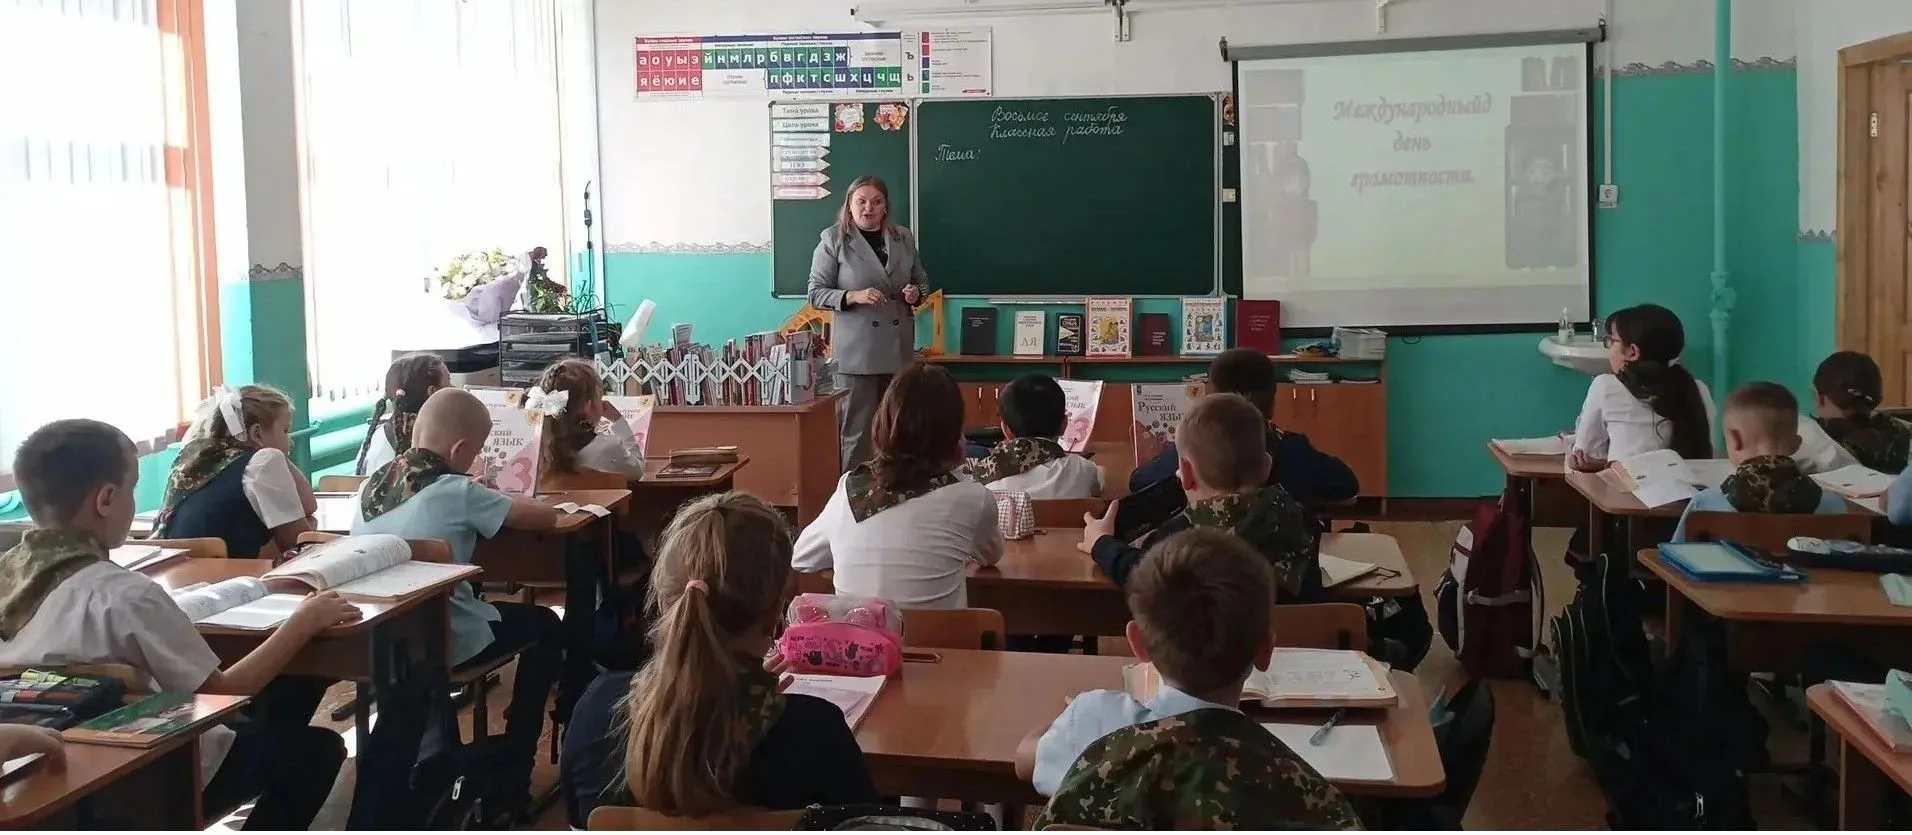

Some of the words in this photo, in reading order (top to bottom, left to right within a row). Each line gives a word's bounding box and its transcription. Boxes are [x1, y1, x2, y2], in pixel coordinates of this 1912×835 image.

[991, 106, 1049, 122] Восьмое
[1064, 105, 1128, 126] сентября
[987, 123, 1057, 139] Классная
[1063, 123, 1124, 144] работа
[1392, 129, 1432, 152] день
[935, 144, 981, 162] Тема:
[1138, 401, 1177, 414] Русский
[1160, 412, 1185, 421] ЯЗЫ
[493, 437, 524, 446] ЯЗЫК
[510, 457, 533, 493] 3
